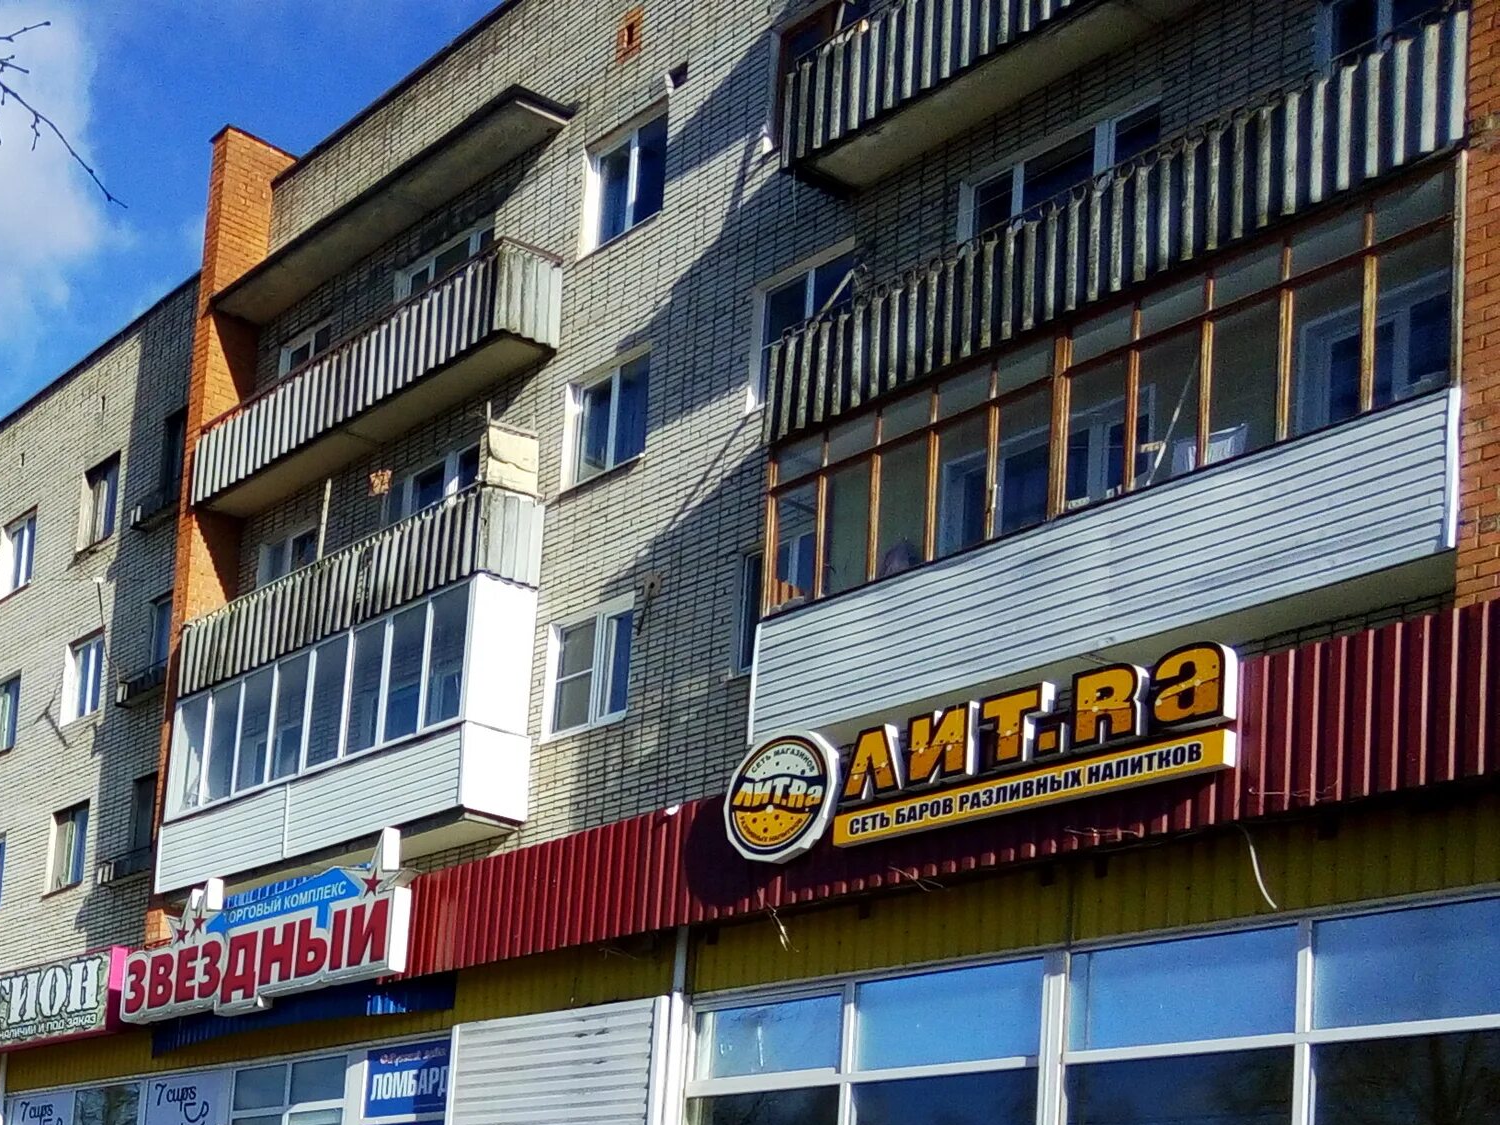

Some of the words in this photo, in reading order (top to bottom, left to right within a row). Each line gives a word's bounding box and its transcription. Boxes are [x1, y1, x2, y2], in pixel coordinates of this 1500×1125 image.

[751, 754, 772, 774] СЕТЬ
[773, 747, 816, 773] МАГАЗИНОВ
[848, 812, 891, 836] СЕТЬ
[894, 798, 954, 826] БАРОВ
[957, 772, 1083, 814] РАЗЛИВНЫХ
[1086, 742, 1203, 785] НАПИТКОВ
[283, 880, 348, 910] КОМПЛЕКС
[45, 1019, 65, 1032] ПОД
[66, 1013, 97, 1028] ЗАКАЗ
[155, 1083, 166, 1106] 7
[166, 1086, 197, 1112] cups
[370, 1066, 449, 1101] ЛОМБАРД
[20, 1101, 29, 1122] 7
[29, 1103, 53, 1125] cups
